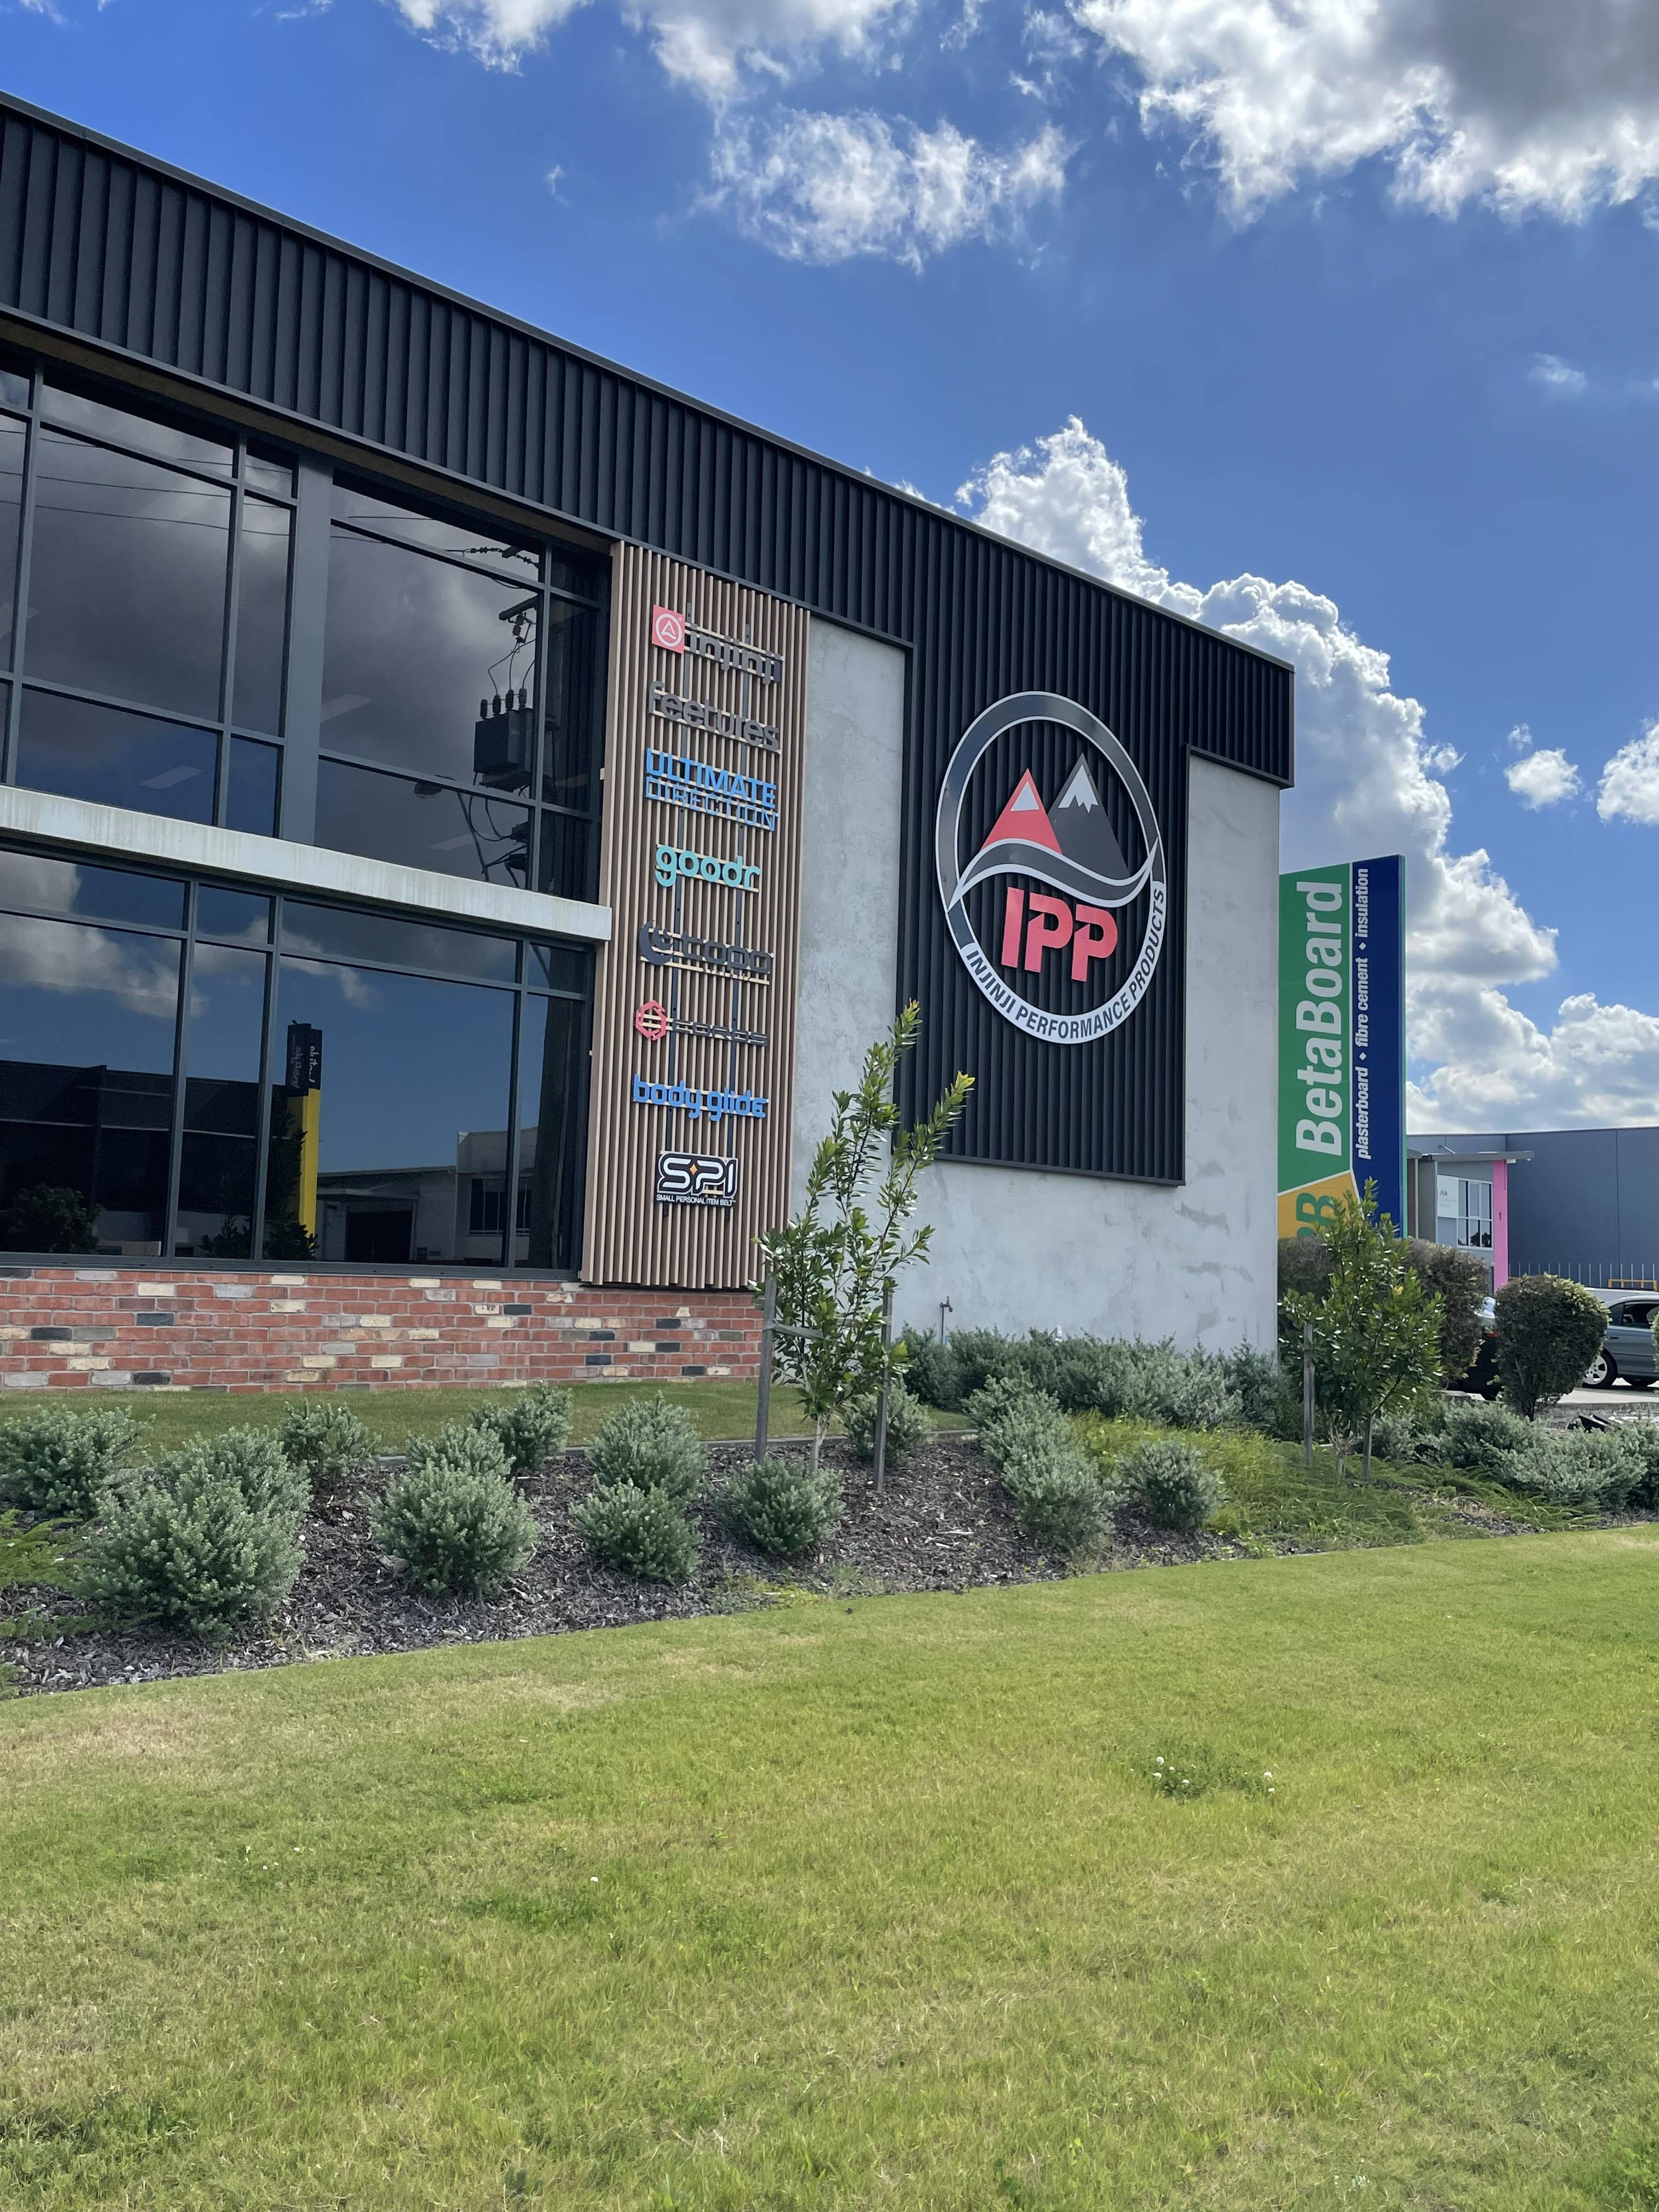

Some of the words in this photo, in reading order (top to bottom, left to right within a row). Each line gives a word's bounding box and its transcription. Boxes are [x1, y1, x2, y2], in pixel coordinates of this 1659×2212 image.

[690, 623, 782, 685] injinji
[648, 681, 780, 752] feetures
[645, 776, 778, 832] DIRECTION
[646, 747, 777, 809] ULTIMATE
[654, 845, 761, 890] goodr
[1355, 868, 1369, 938] insulation
[966, 950, 1017, 1014] INJINJI
[1015, 993, 1131, 1039] PERFORMANCE
[1129, 888, 1164, 1001] PRODUCTS
[1001, 887, 1118, 982] IPP
[1355, 957, 1369, 1011] cement
[1296, 881, 1343, 1156] BetaBoard
[1355, 1014, 1369, 1047] fibre
[633, 1073, 701, 1119] body
[707, 1086, 769, 1121] glide
[1355, 1066, 1372, 1160] plasterboard
[656, 1194, 675, 1202] SMALL
[675, 1195, 706, 1204] PERSONAL
[661, 1155, 735, 1194] SPI
